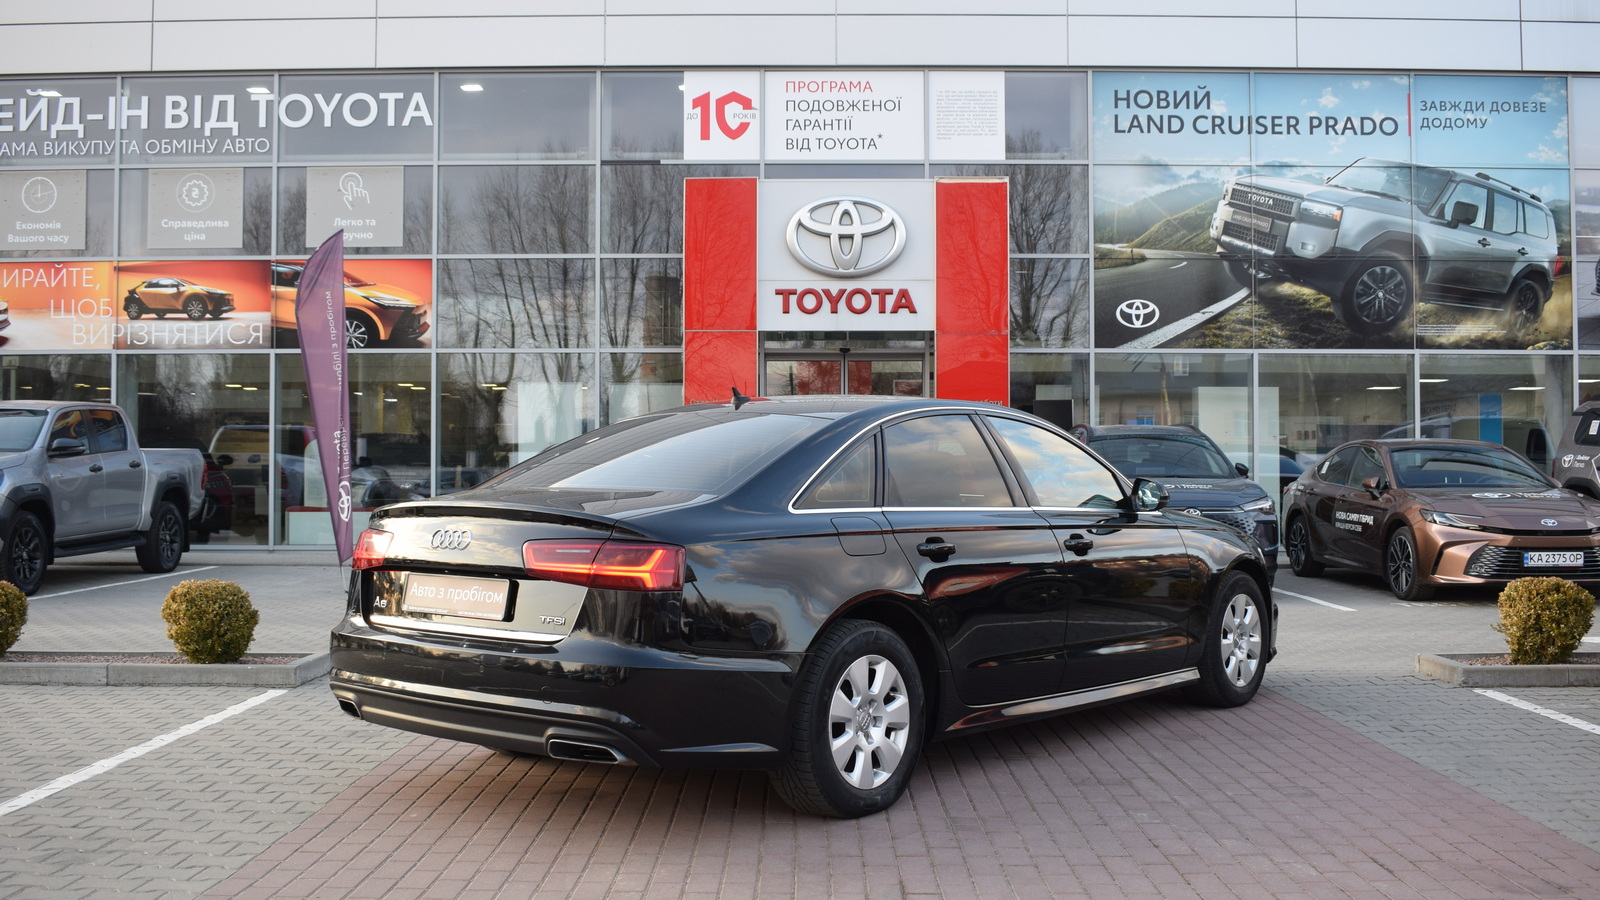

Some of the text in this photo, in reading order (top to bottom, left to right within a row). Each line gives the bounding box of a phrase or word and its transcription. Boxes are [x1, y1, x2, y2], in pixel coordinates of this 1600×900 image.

[785, 80, 873, 93] ПРОГРАМА
[785, 97, 902, 113] ПОДОВЖЕНОЇ
[1114, 85, 1211, 111] НОВИЙ
[0, 89, 433, 138] ЕЙД-ІН ВІД TOYOTA
[1419, 100, 1547, 115] ЗАВЖДИ ДОВЕЗЕ
[785, 115, 854, 131] ГАРАНТІЇ
[1114, 115, 1399, 137] LAND CRUISER PRADO
[1419, 117, 1488, 131] ДОДОМУ
[44, 140, 115, 156] ВИКУПУ
[120, 140, 140, 155] ТА
[145, 138, 218, 155] ОБМІНУ
[223, 138, 270, 154] АВТО
[785, 137, 811, 152] ВІД
[1248, 194, 1273, 205] TOYOTA
[16, 221, 61, 230] Економія
[161, 219, 229, 229] Справедлива
[334, 217, 363, 227] Легко
[8, 234, 69, 244] Вашого часу
[184, 232, 206, 242] ціна
[343, 232, 373, 241] ручно
[3, 264, 100, 291] ИРАЙТЕ,
[775, 288, 918, 314] TOYOTA
[50, 298, 113, 322] ЩОБ
[325, 291, 337, 340] пробігом
[73, 322, 264, 346] ВИРІЗНЯТИСЯ
[1529, 553, 1583, 563] KA 2375 OP
[410, 582, 503, 605] Авто з пробігом
[373, 596, 388, 608] A6
[539, 615, 566, 626] TFSI
